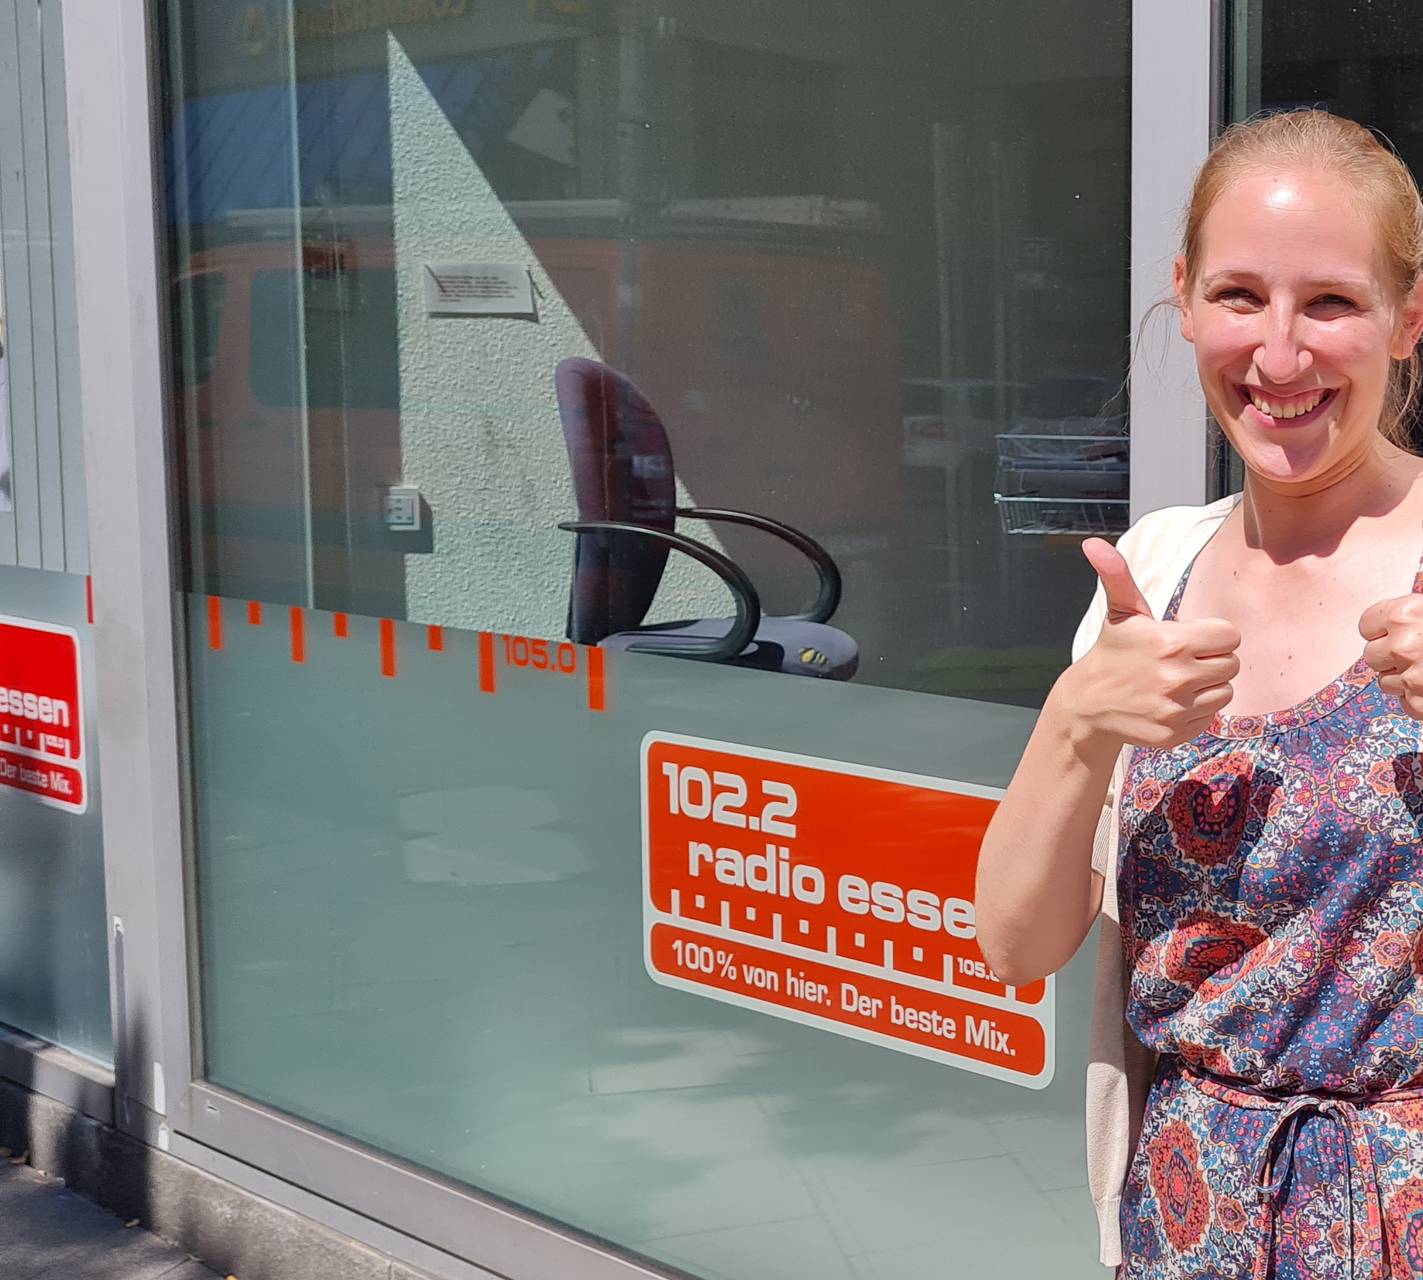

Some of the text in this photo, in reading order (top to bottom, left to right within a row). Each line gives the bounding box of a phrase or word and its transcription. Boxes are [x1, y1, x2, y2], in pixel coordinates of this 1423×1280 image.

[502, 634, 577, 675] 105.0
[663, 762, 798, 838] 102.2
[689, 842, 976, 939] radio esse
[672, 940, 1016, 1056] 100% von hier. Der beste Mix.
